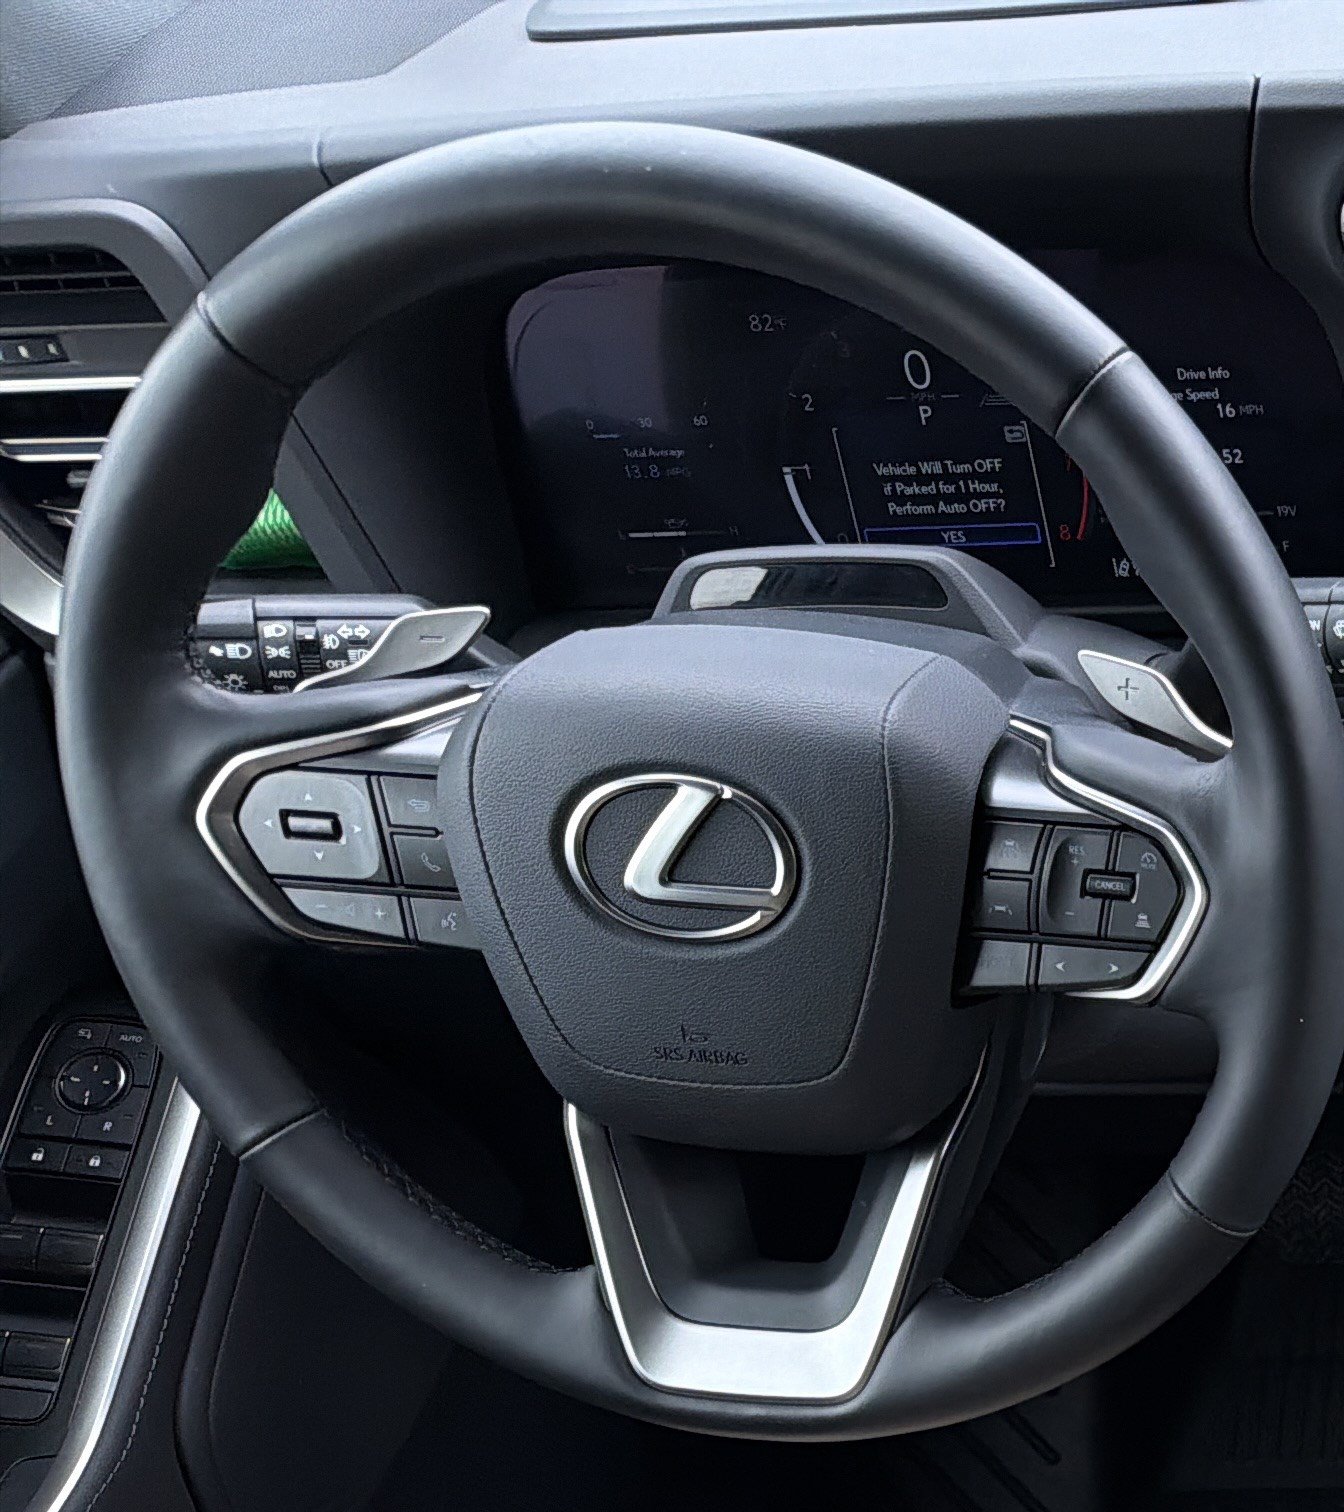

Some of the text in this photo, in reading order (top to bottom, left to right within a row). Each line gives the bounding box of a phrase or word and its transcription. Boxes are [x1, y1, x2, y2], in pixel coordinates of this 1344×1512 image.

[903, 350, 931, 390] 0
[1176, 366, 1231, 381] Drive Info
[800, 394, 815, 412] 2
[1185, 388, 1220, 402] Speed
[918, 405, 932, 426] P
[1216, 403, 1264, 418] 16 MPH
[693, 415, 709, 426] 60
[1221, 449, 1244, 465] 52
[872, 458, 1003, 476] Vehicle Will Turn OFF
[883, 482, 892, 496] if
[896, 481, 936, 496] Parked
[939, 481, 956, 494] for
[959, 480, 966, 493] 1
[887, 499, 1006, 516] Perform Auto OFF?
[940, 530, 966, 544] YES
[1059, 524, 1071, 541] 8
[267, 669, 297, 679] AUTO
[1094, 880, 1127, 892] CANCEL
[119, 1034, 143, 1043] AUTO
[653, 1046, 749, 1066] SRS AIRBAG
